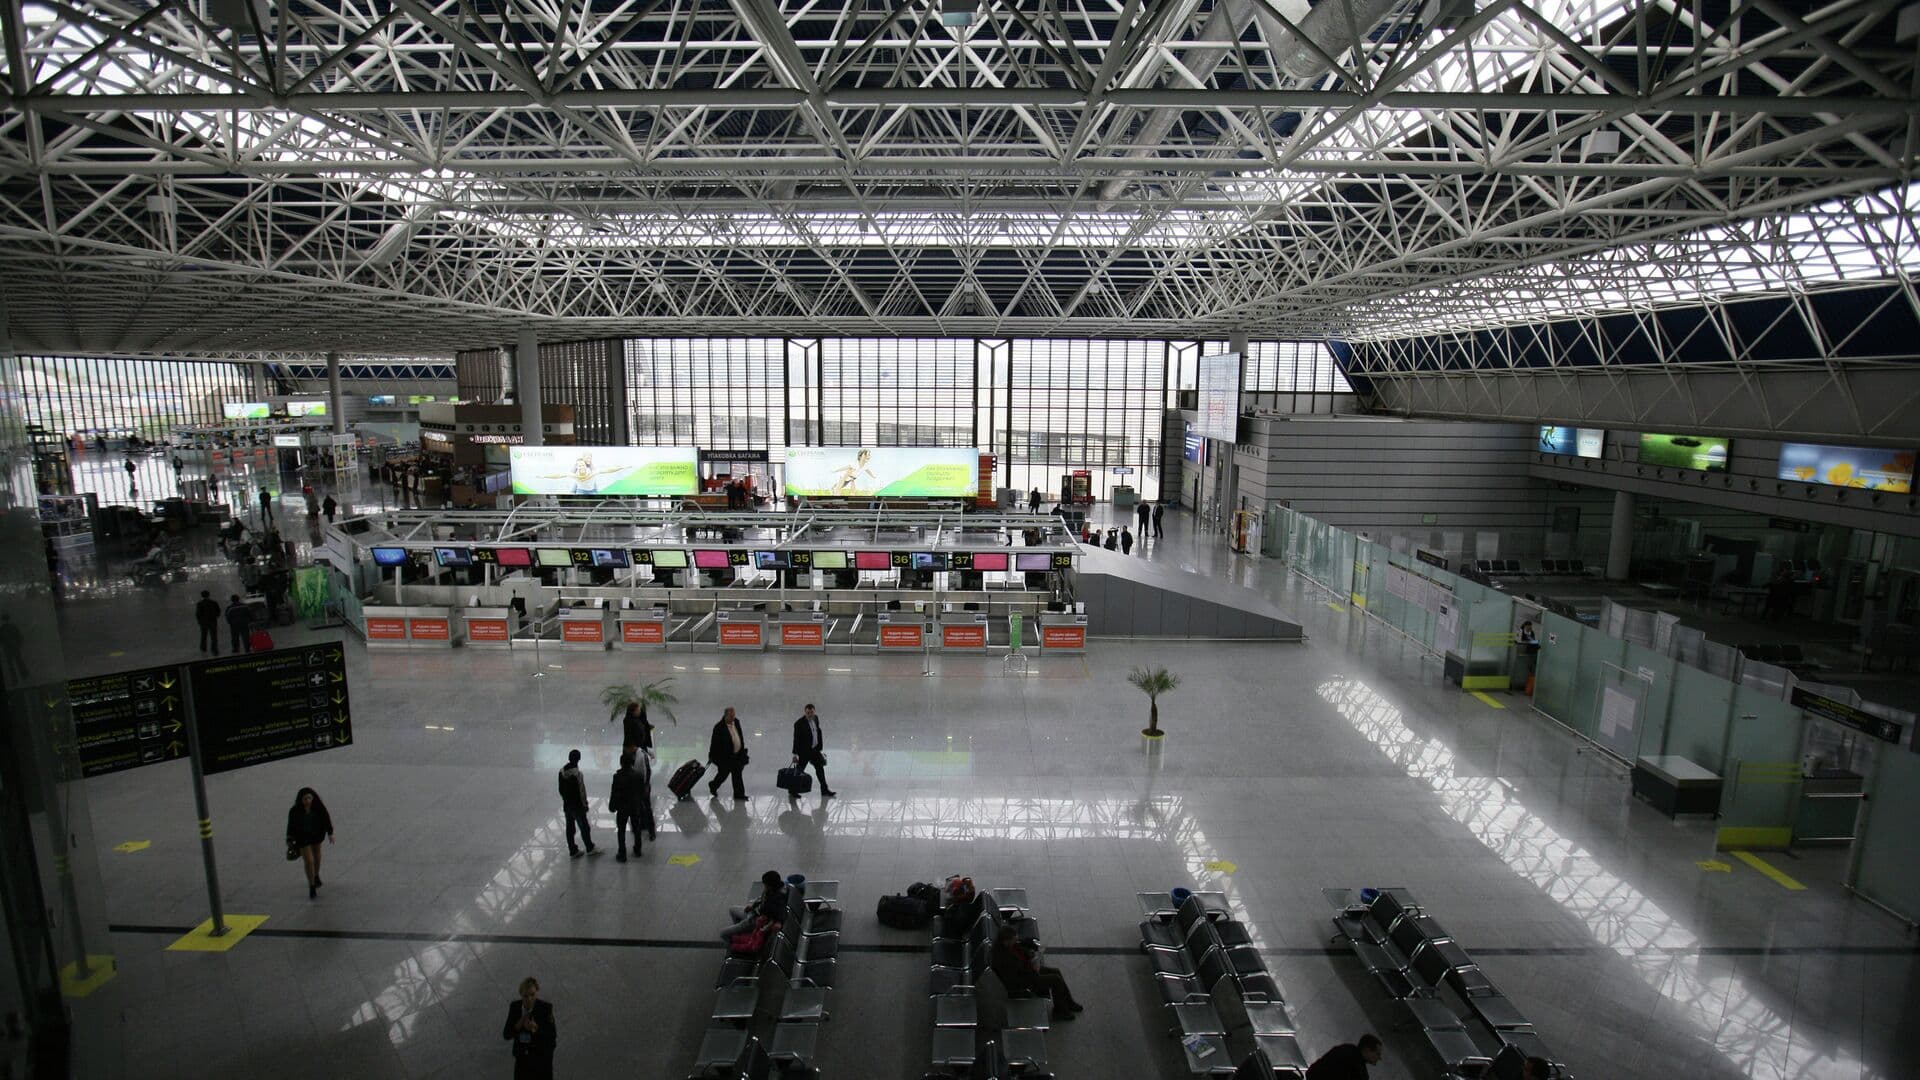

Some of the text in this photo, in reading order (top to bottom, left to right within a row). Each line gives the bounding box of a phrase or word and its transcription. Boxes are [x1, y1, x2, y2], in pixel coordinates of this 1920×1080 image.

[475, 435, 523, 444] ШОКОЛАДН
[479, 551, 493, 560] 31
[575, 551, 589, 561] 32
[635, 552, 649, 561] 33
[733, 553, 747, 562] 34
[795, 554, 809, 563] 35
[894, 555, 908, 564] 36
[955, 555, 969, 564] 37
[1056, 556, 1070, 565] 38
